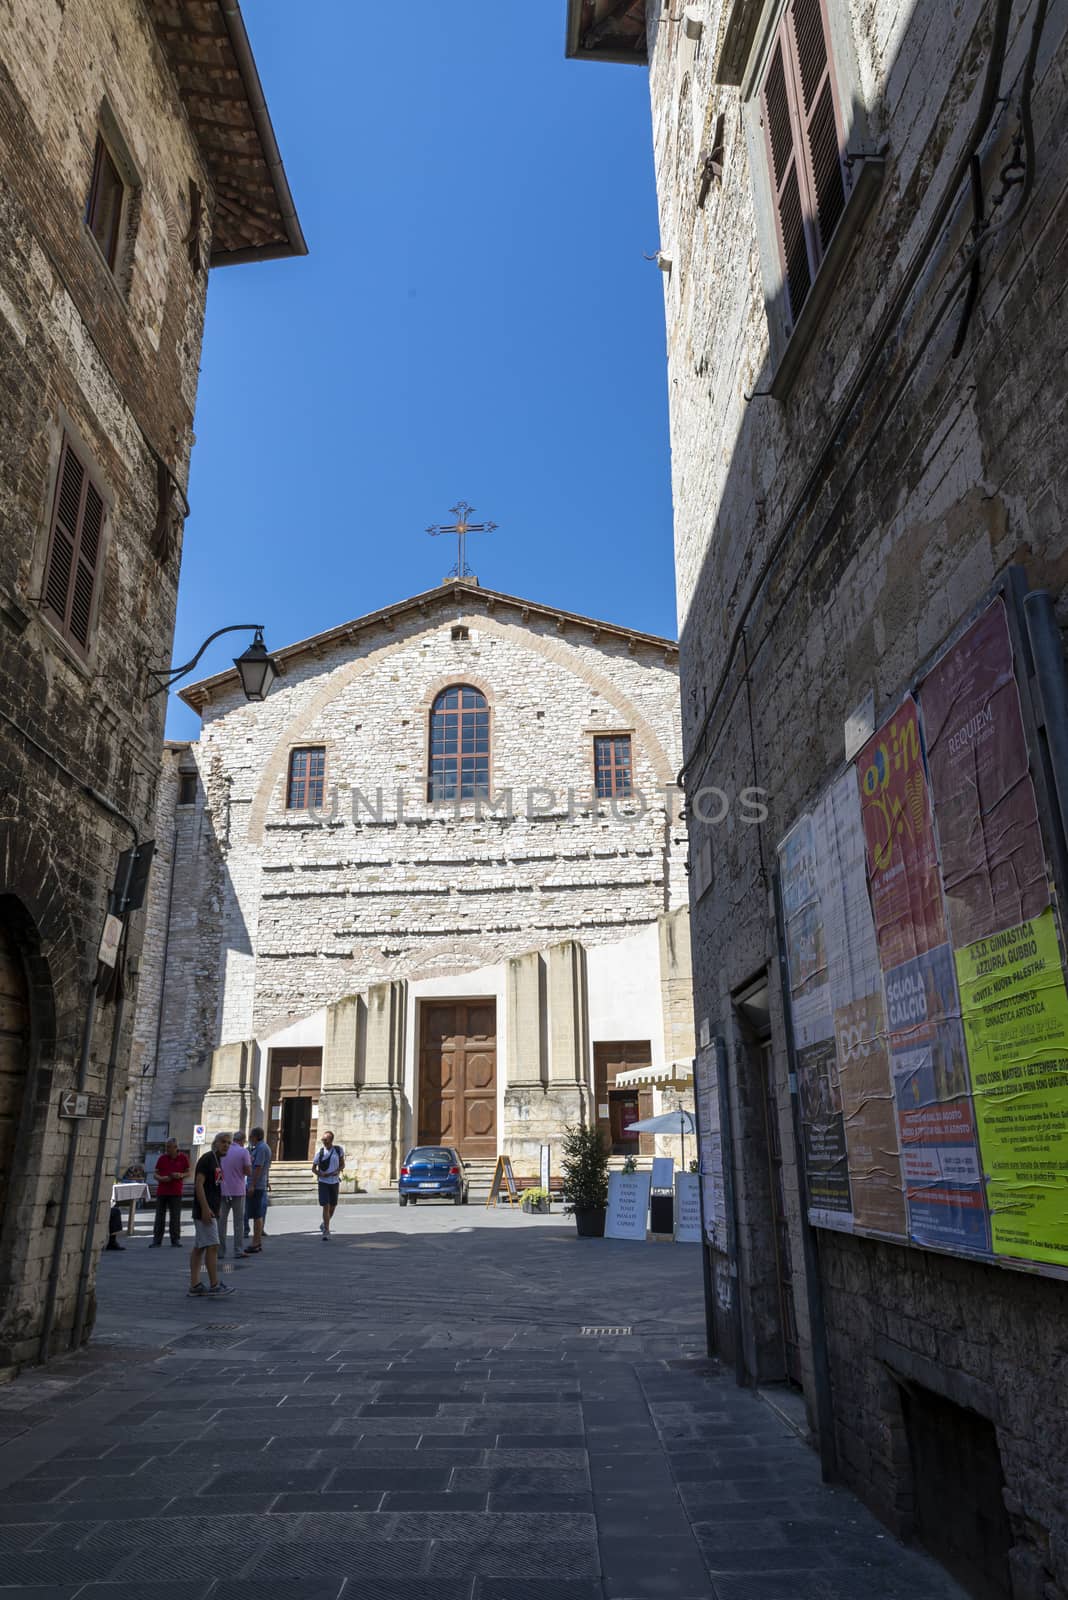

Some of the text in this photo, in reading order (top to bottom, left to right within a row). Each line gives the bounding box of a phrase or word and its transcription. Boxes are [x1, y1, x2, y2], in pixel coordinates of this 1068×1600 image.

[949, 704, 992, 753] REQUIEM
[990, 923, 1034, 952] GINNASTICA
[976, 940, 1037, 976] AZZURRA GUBBIO
[887, 971, 924, 1002] SCUOLA
[994, 976, 1012, 992] NUOVA
[890, 993, 926, 1024] CALCIO
[1016, 1002, 1044, 1018] ARTISTICA
[1027, 1059, 1057, 1076] SETTEMBRE
